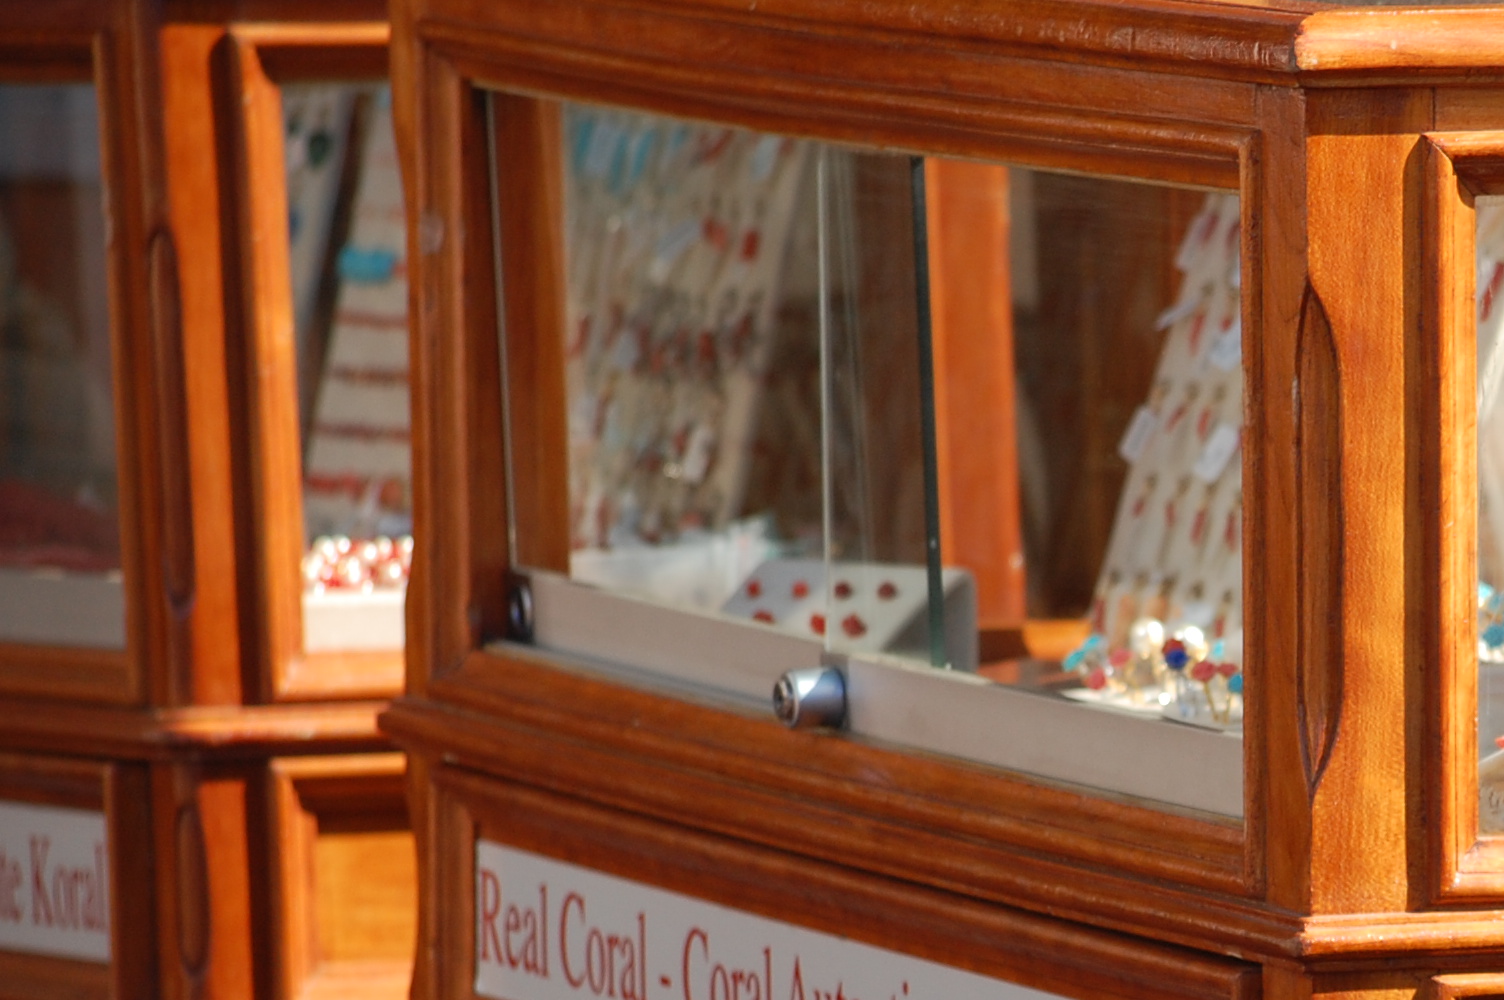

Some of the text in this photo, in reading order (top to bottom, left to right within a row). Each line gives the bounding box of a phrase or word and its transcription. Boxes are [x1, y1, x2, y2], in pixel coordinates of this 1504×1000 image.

[30, 834, 109, 932] Koral
[480, 868, 549, 979] Real
[659, 974, 671, 988] -
